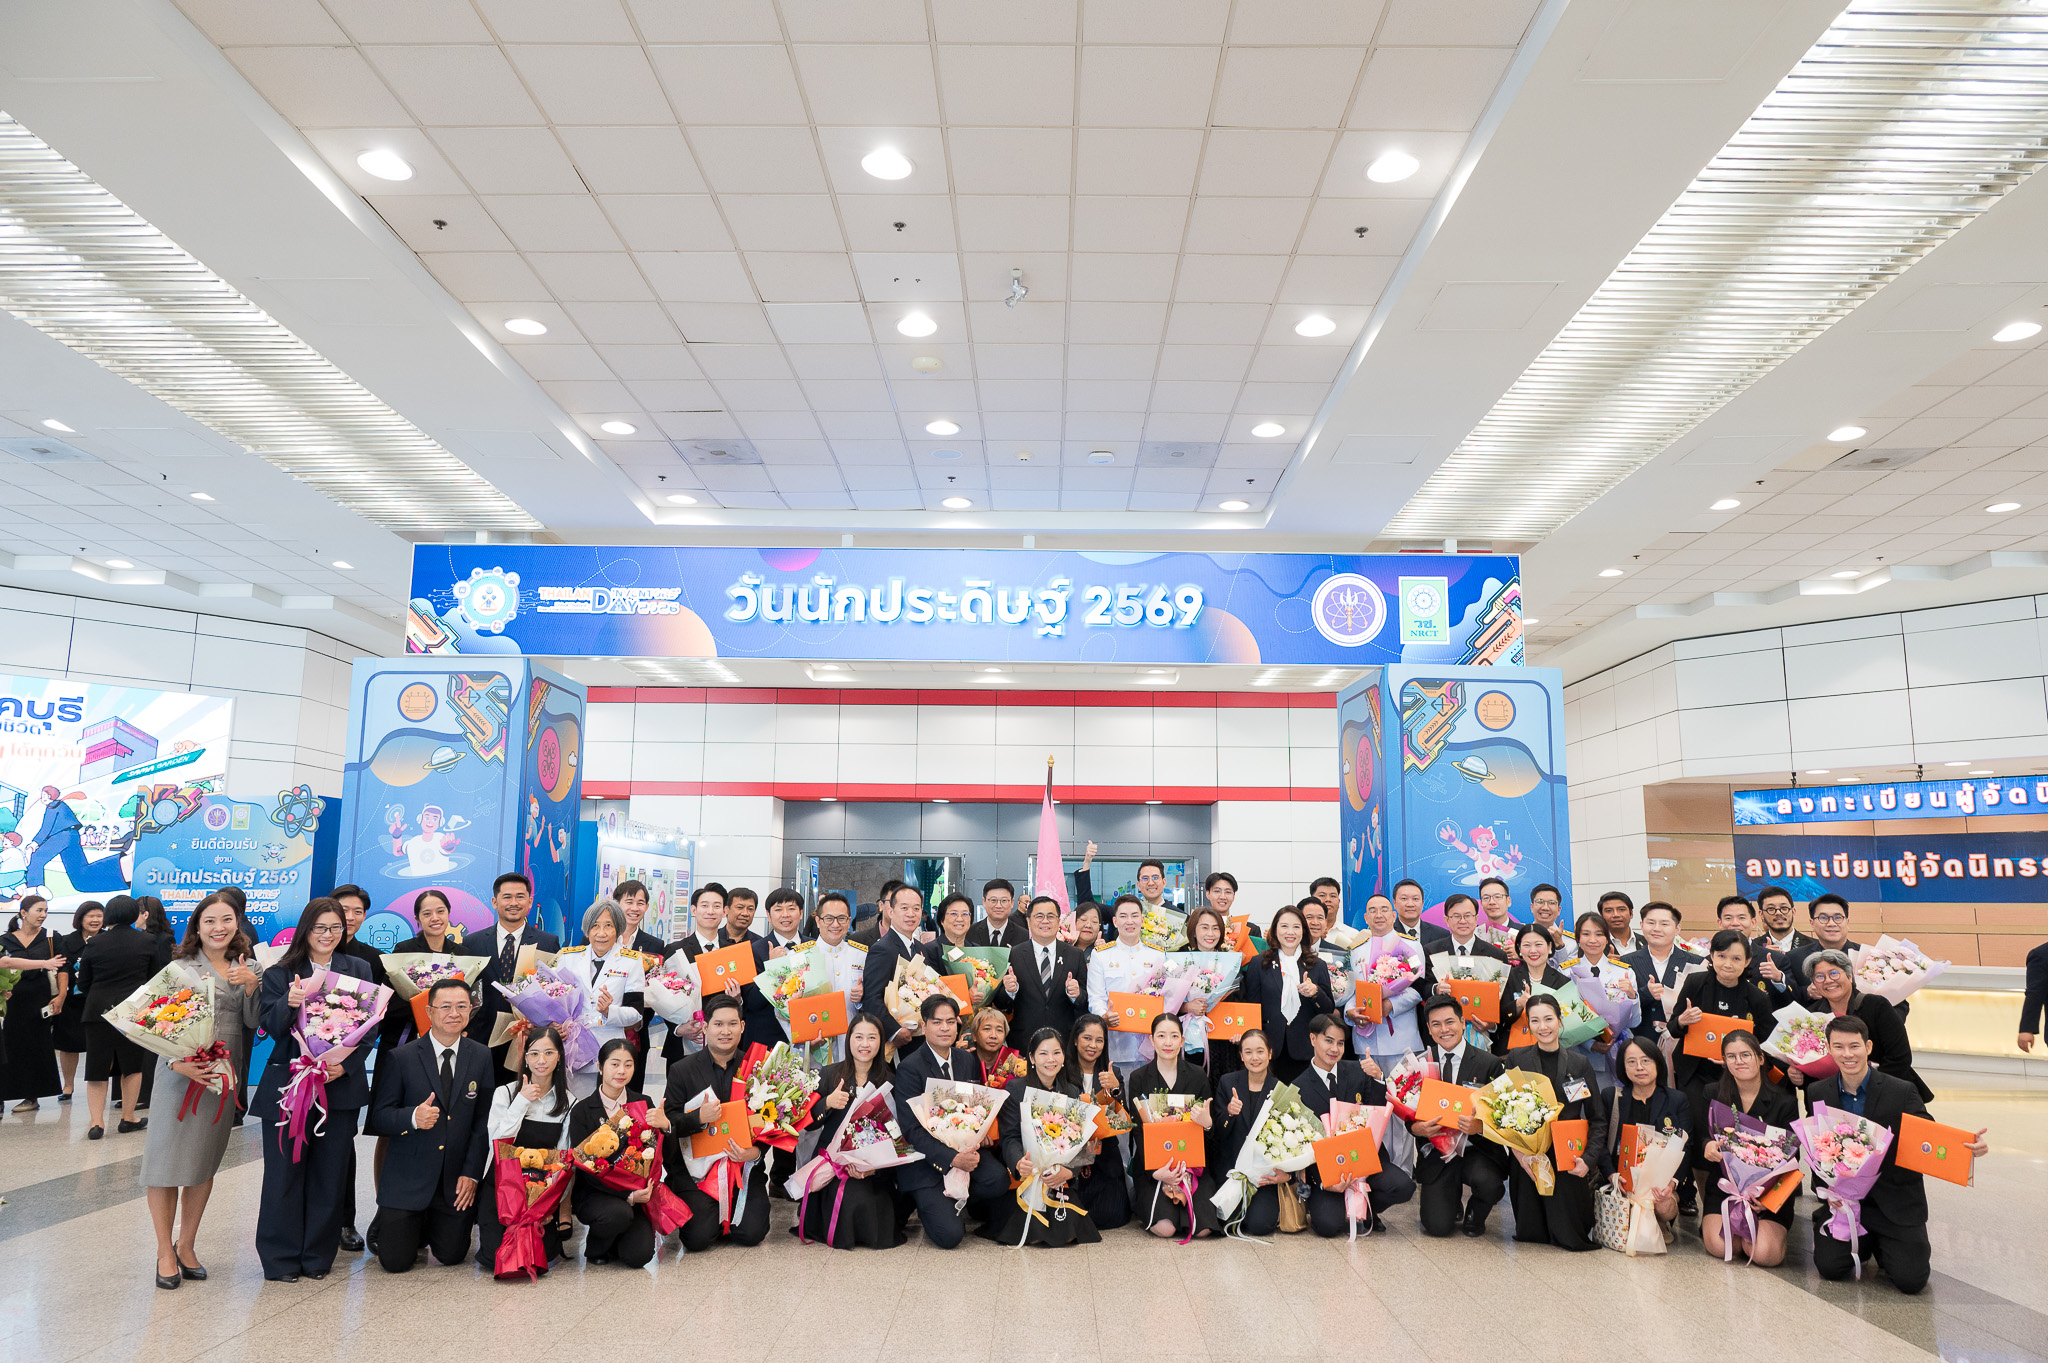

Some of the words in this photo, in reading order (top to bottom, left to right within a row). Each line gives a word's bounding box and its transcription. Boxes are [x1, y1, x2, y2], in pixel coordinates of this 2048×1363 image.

[727, 574, 1071, 636] วันนักประดิษฐ์
[1084, 585, 1204, 625] 2569
[191, 837, 258, 850] ยินดีต้อนรับ
[214, 855, 233, 865] สู่งาน
[147, 868, 257, 887] วันนักประดิษฐ์
[259, 870, 299, 885] 2569
[170, 915, 178, 925] 5
